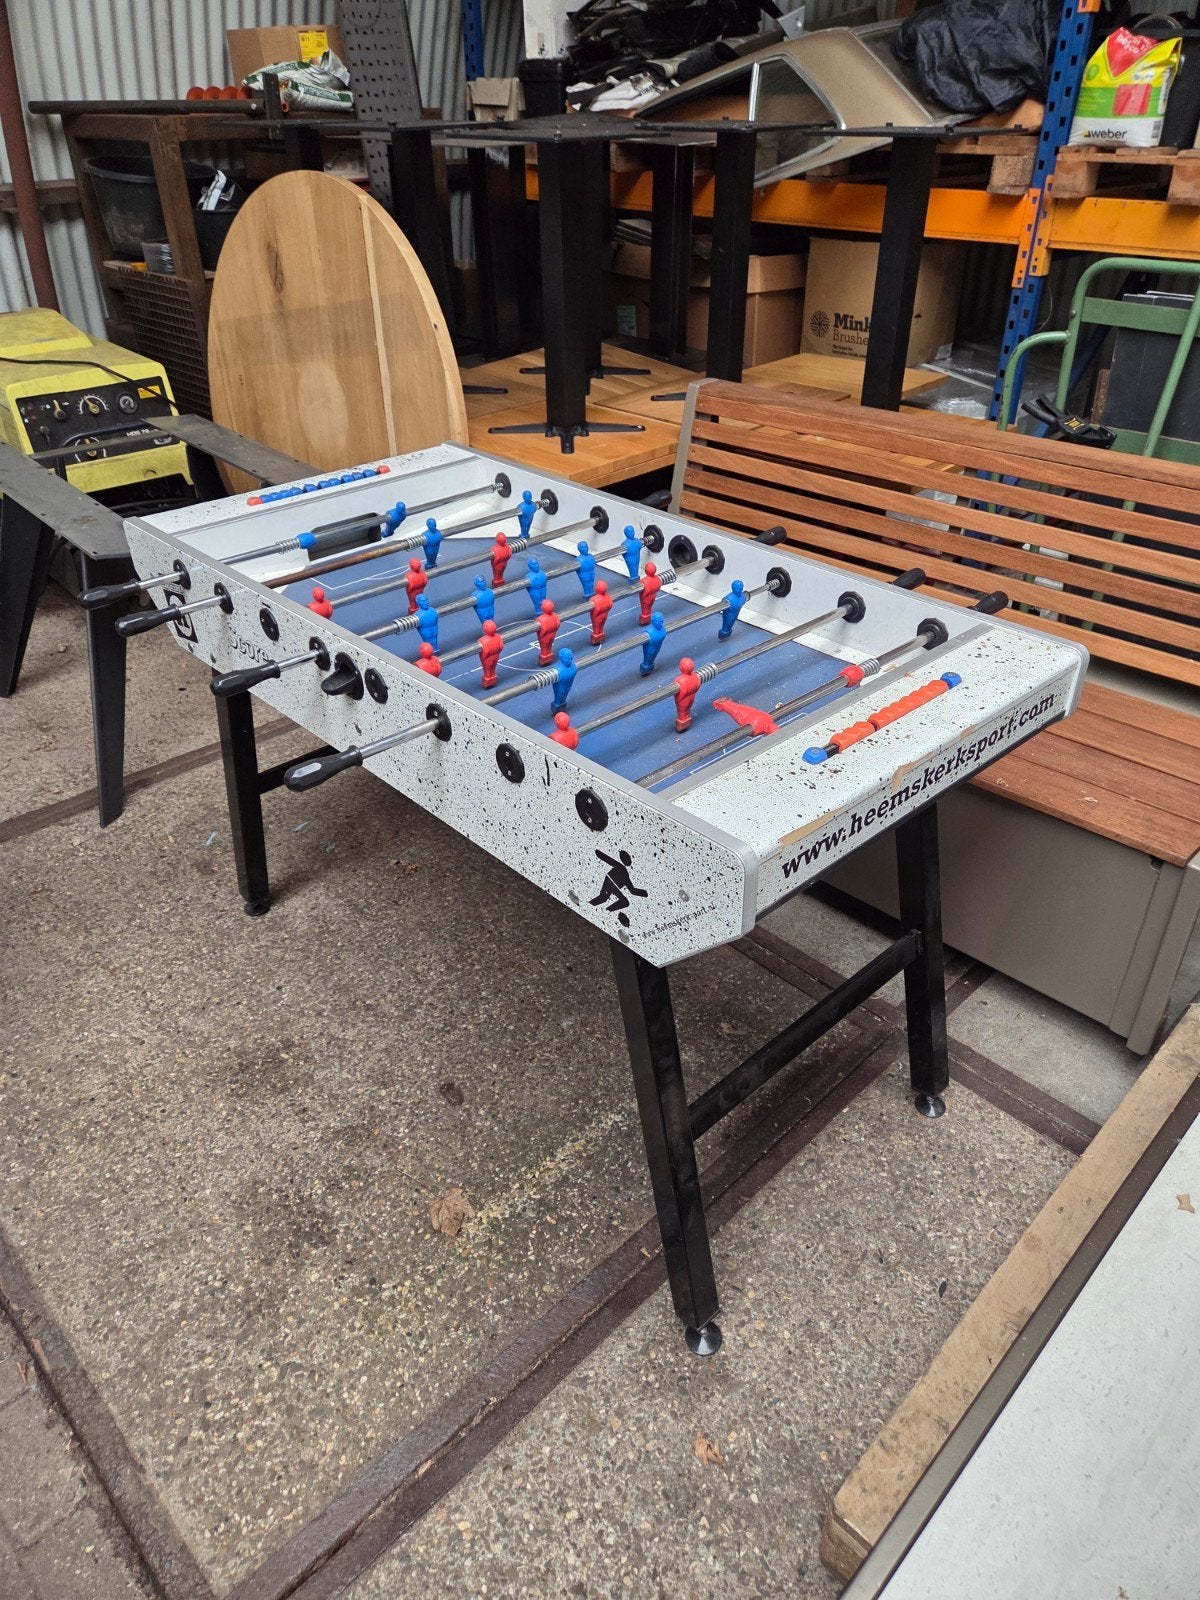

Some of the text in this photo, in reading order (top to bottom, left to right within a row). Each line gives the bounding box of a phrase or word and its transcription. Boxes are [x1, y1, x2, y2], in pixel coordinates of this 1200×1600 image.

[1091, 128, 1127, 139] weber
[832, 329, 869, 345] Brushe
[780, 692, 1056, 879] www.heemskerksport.com
